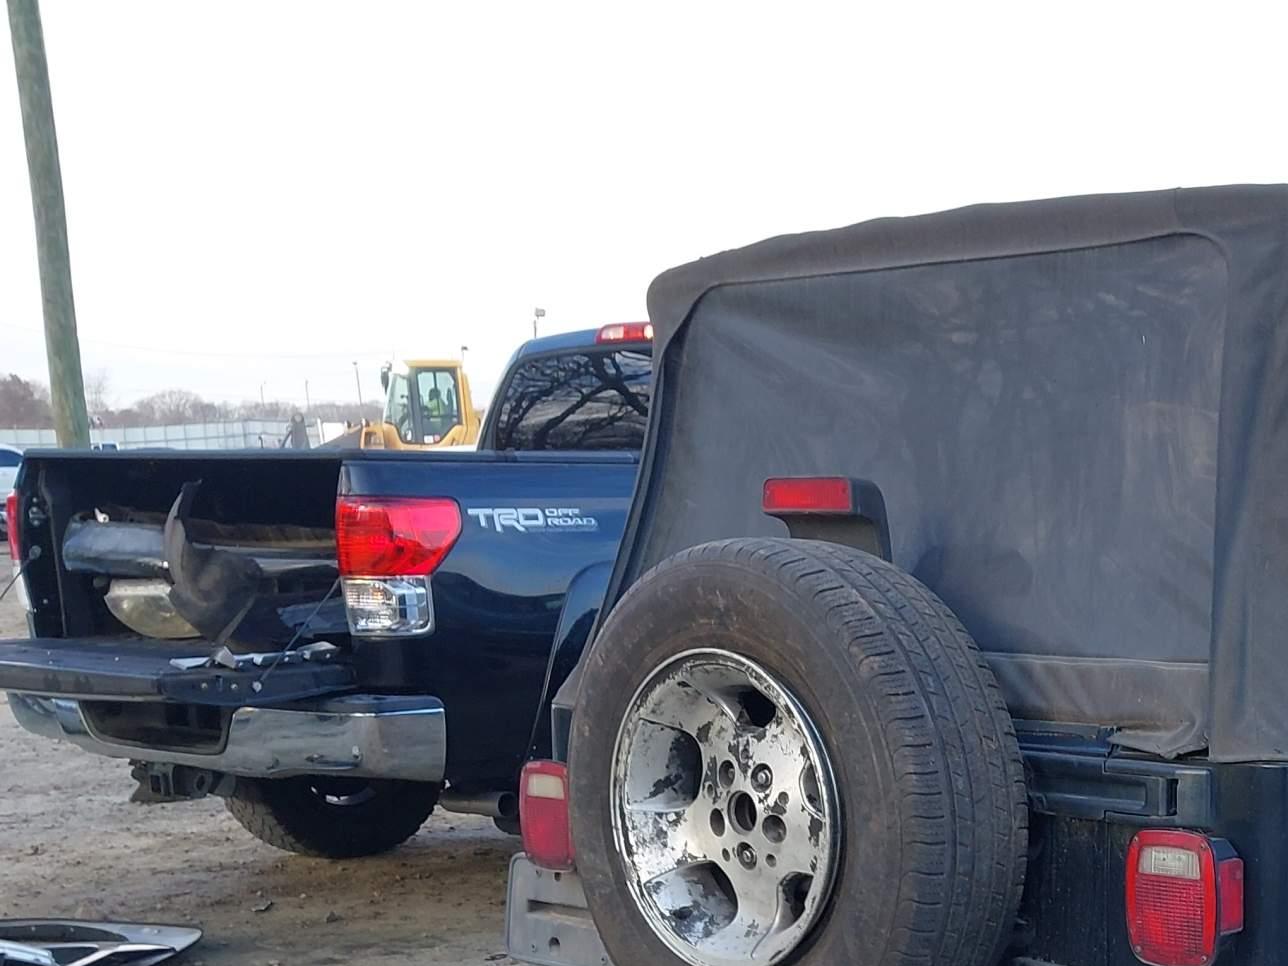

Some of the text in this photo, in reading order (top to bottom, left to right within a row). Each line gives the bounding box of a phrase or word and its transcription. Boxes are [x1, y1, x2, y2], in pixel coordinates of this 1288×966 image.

[545, 508, 579, 516] OFF
[467, 508, 546, 533] TRD
[546, 517, 597, 526] ROAD
